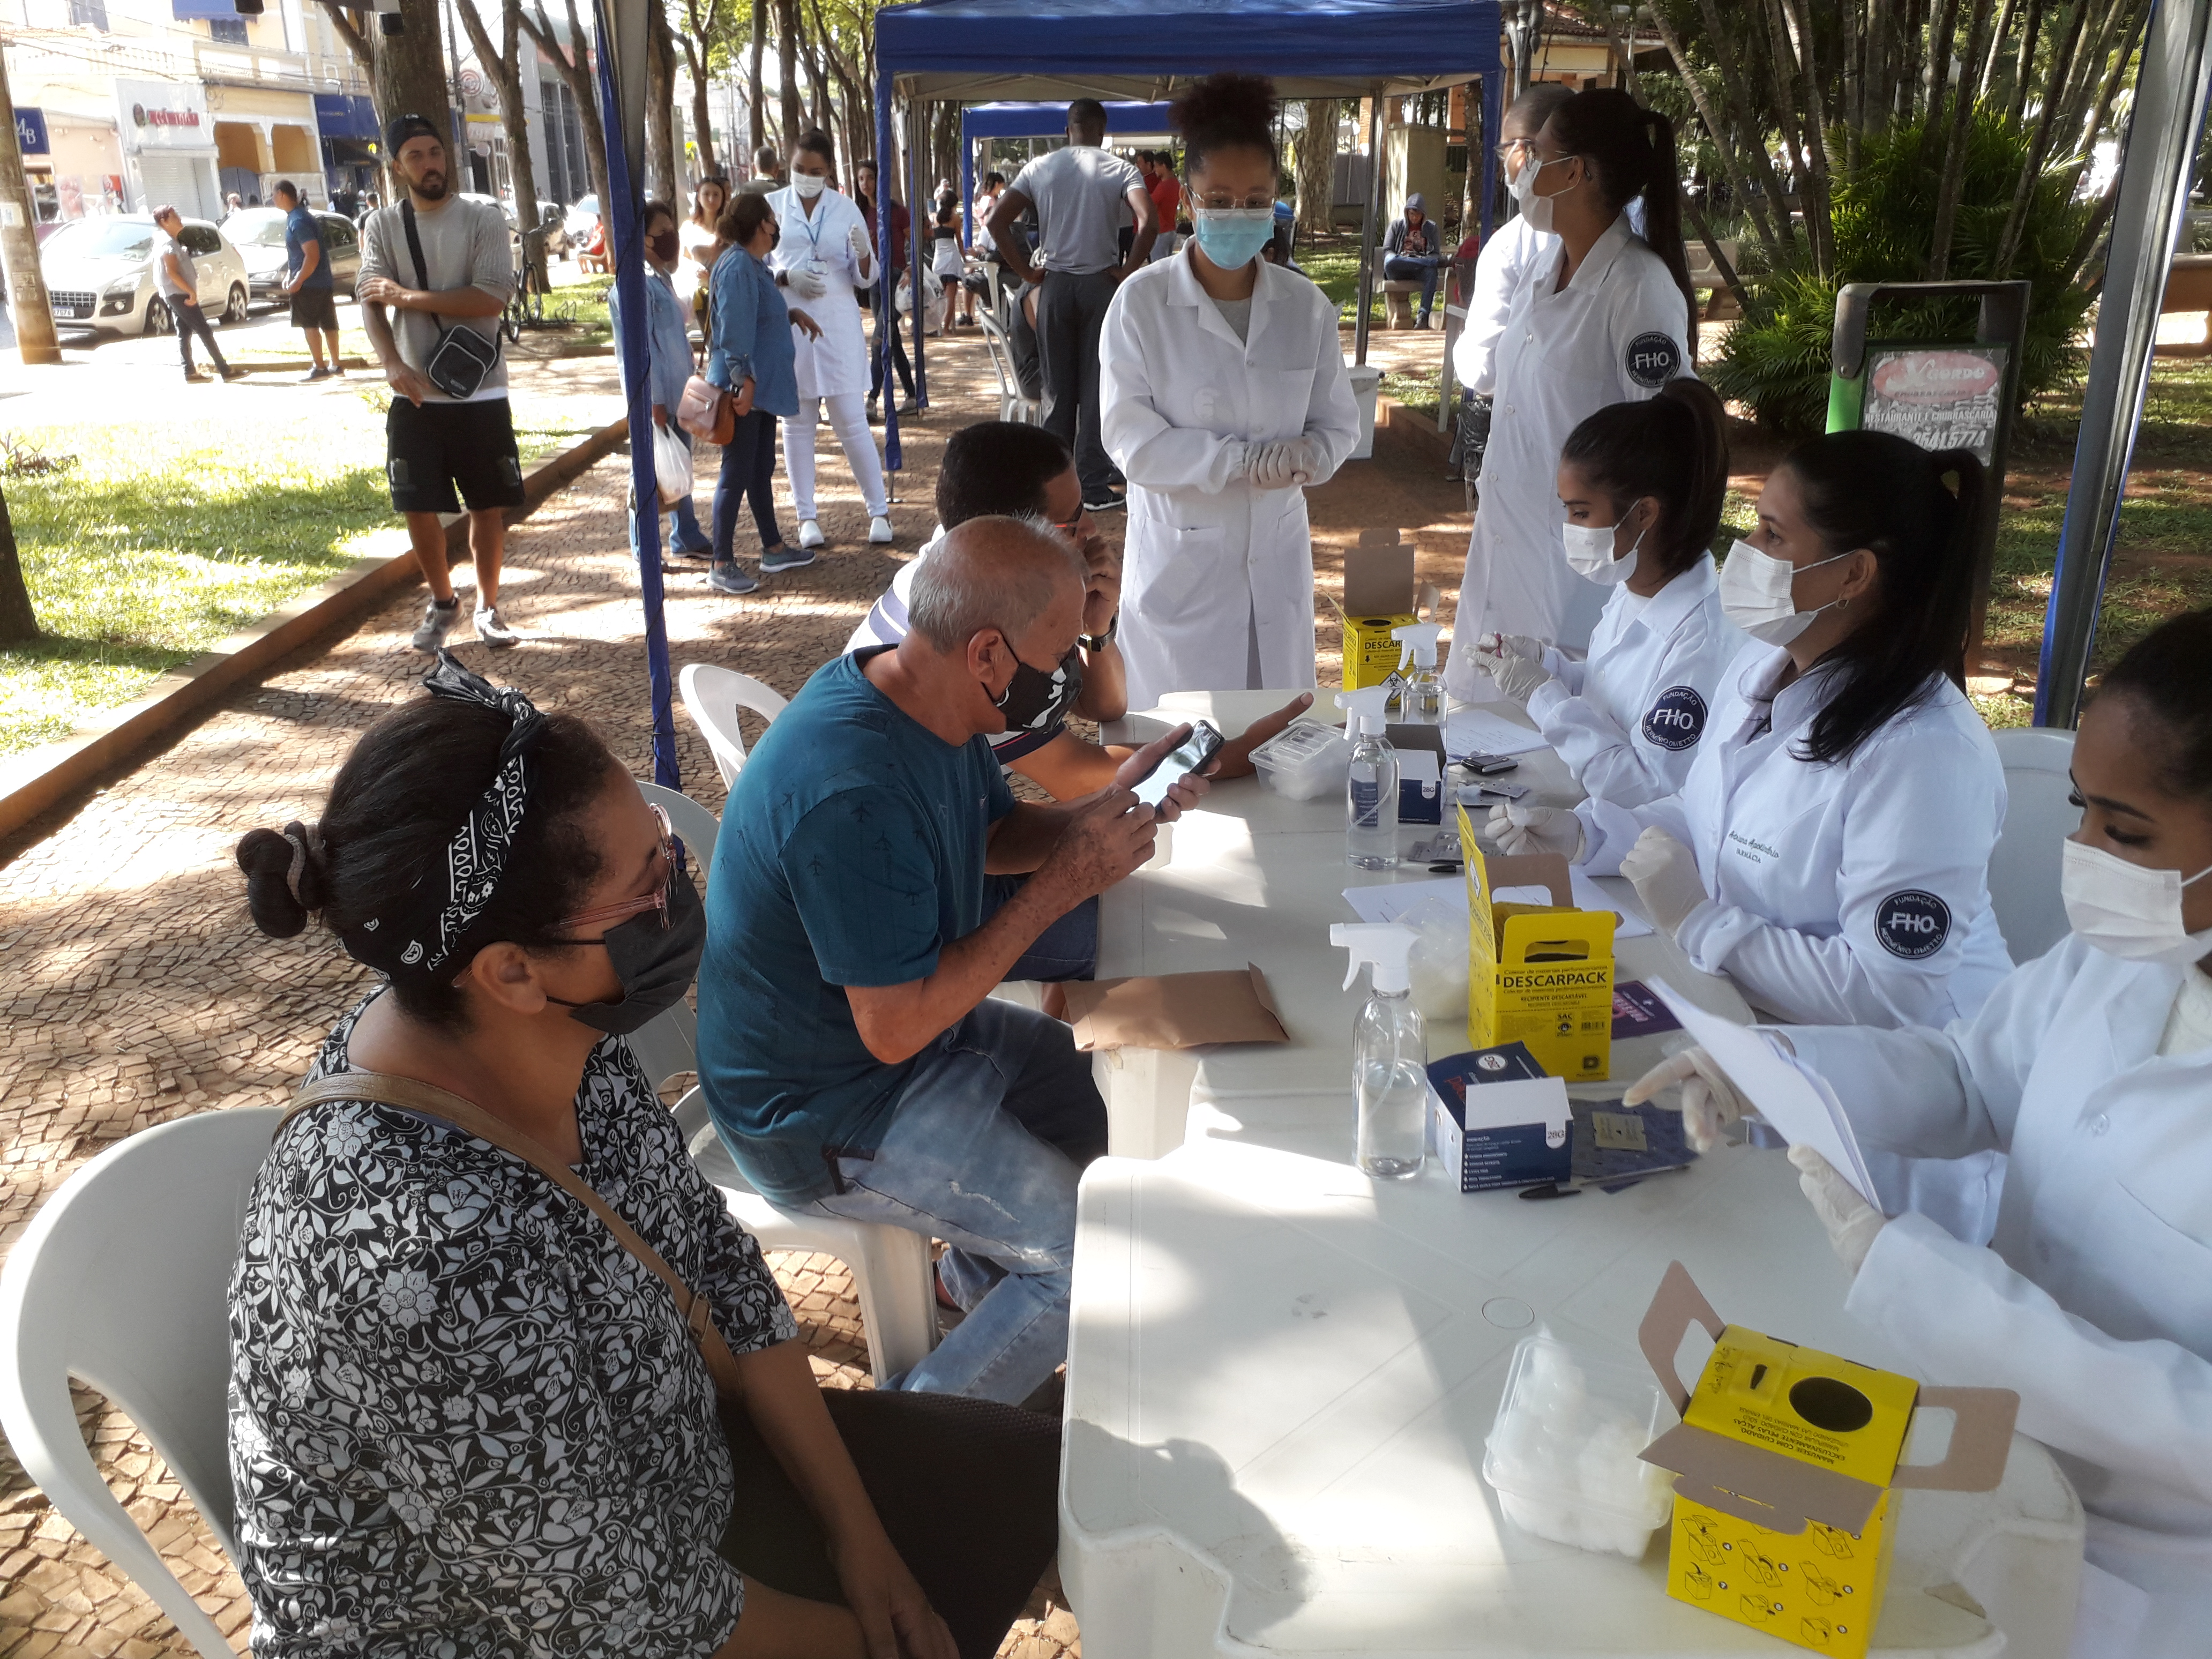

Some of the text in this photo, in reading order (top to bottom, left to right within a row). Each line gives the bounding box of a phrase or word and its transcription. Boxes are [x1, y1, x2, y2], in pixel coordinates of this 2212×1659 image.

[1635, 352, 1669, 369] FHO
[1926, 368, 1984, 380] GORDO
[1365, 640, 1402, 649] DESCAR
[1662, 691, 1697, 706] FUNDAÇÃO
[1653, 708, 1694, 730] FHO
[1669, 734, 1696, 747] OMETTO
[1894, 895, 1937, 909] FUNDAÇÃO
[1891, 911, 1935, 933] FHO
[1914, 933, 1942, 954] OMETTO
[1503, 971, 1607, 988] DESCARPACK
[1761, 1421, 1788, 1434] CUIDADO
[1733, 1418, 1845, 1461] EXCLUSIVAMENTE PELAS ALÇAS
[1741, 1428, 1774, 1443] CUIDADO
[1776, 1440, 1793, 1449] COM
